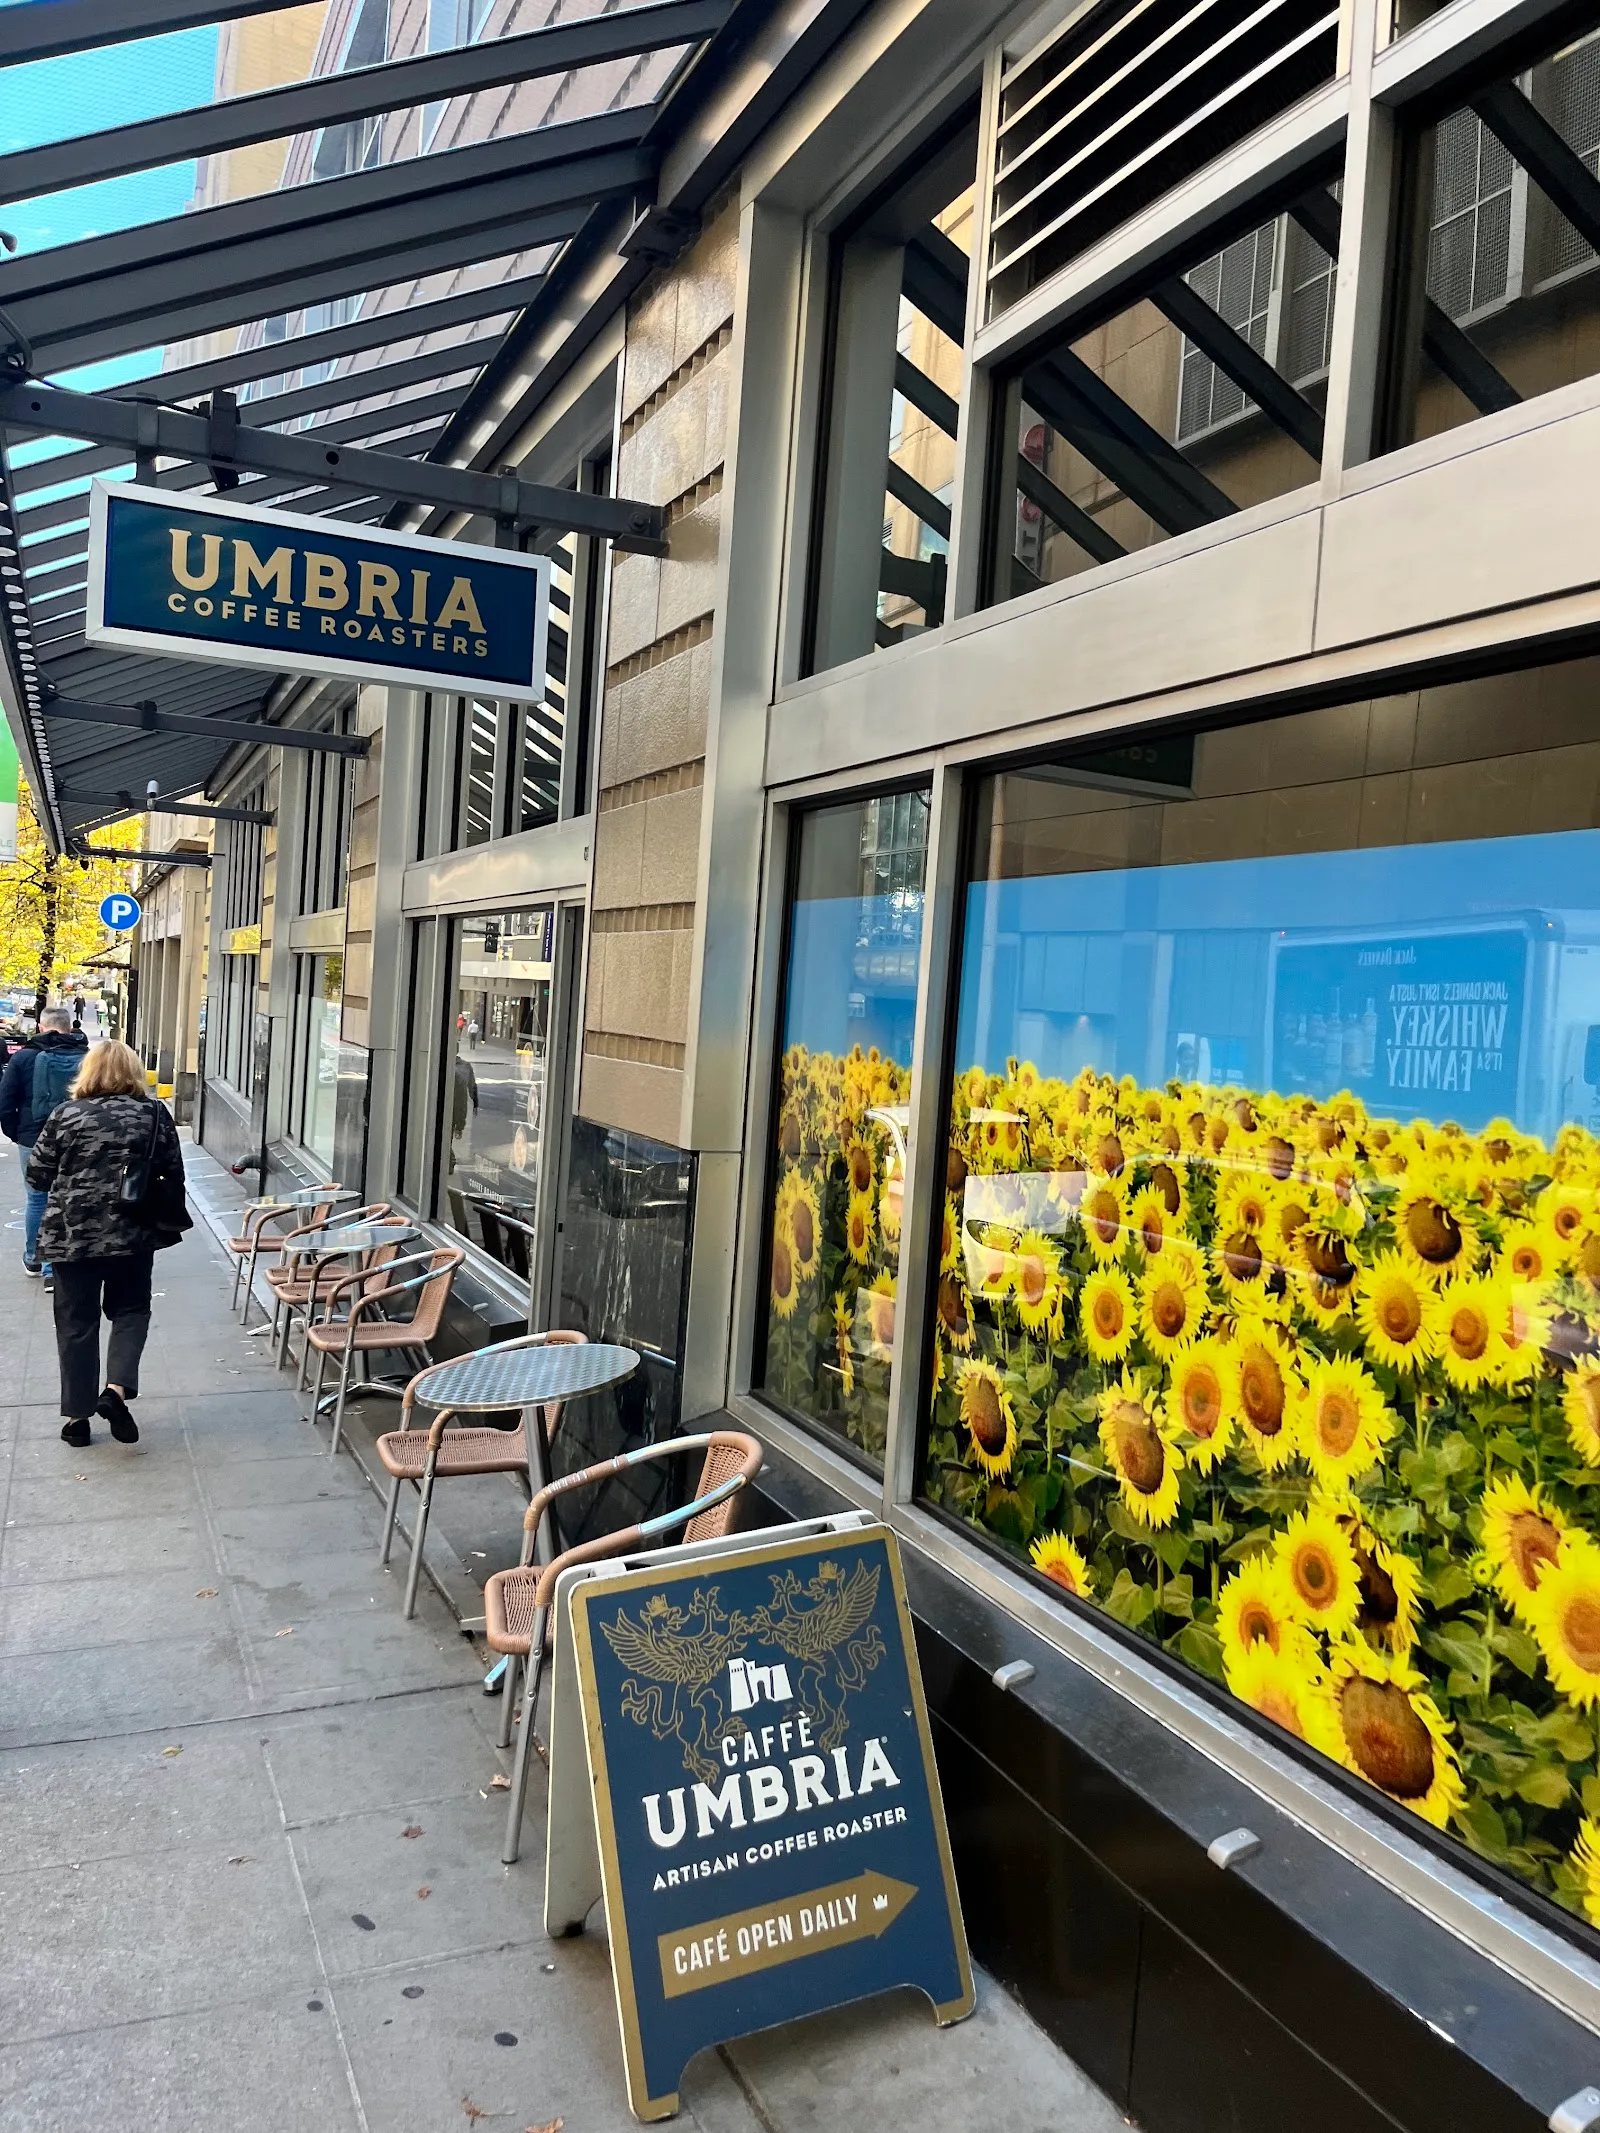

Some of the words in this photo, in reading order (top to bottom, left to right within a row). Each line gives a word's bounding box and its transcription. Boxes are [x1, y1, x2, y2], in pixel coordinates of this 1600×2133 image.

[168, 528, 487, 634] UMBRIA
[168, 592, 301, 630] COFFEE
[320, 617, 488, 657] ROASTERS
[111, 899, 132, 923] P
[721, 1711, 815, 1767] CAFFÈ
[642, 1738, 901, 1848] UMBRIA
[653, 1852, 738, 1891] ARTISAN
[746, 1830, 819, 1864] COFFEE
[823, 1807, 907, 1842] ROASTER
[673, 1928, 731, 1976] CAFÉ
[737, 1912, 793, 1956] OPEN
[800, 1894, 859, 1938] DAILY
